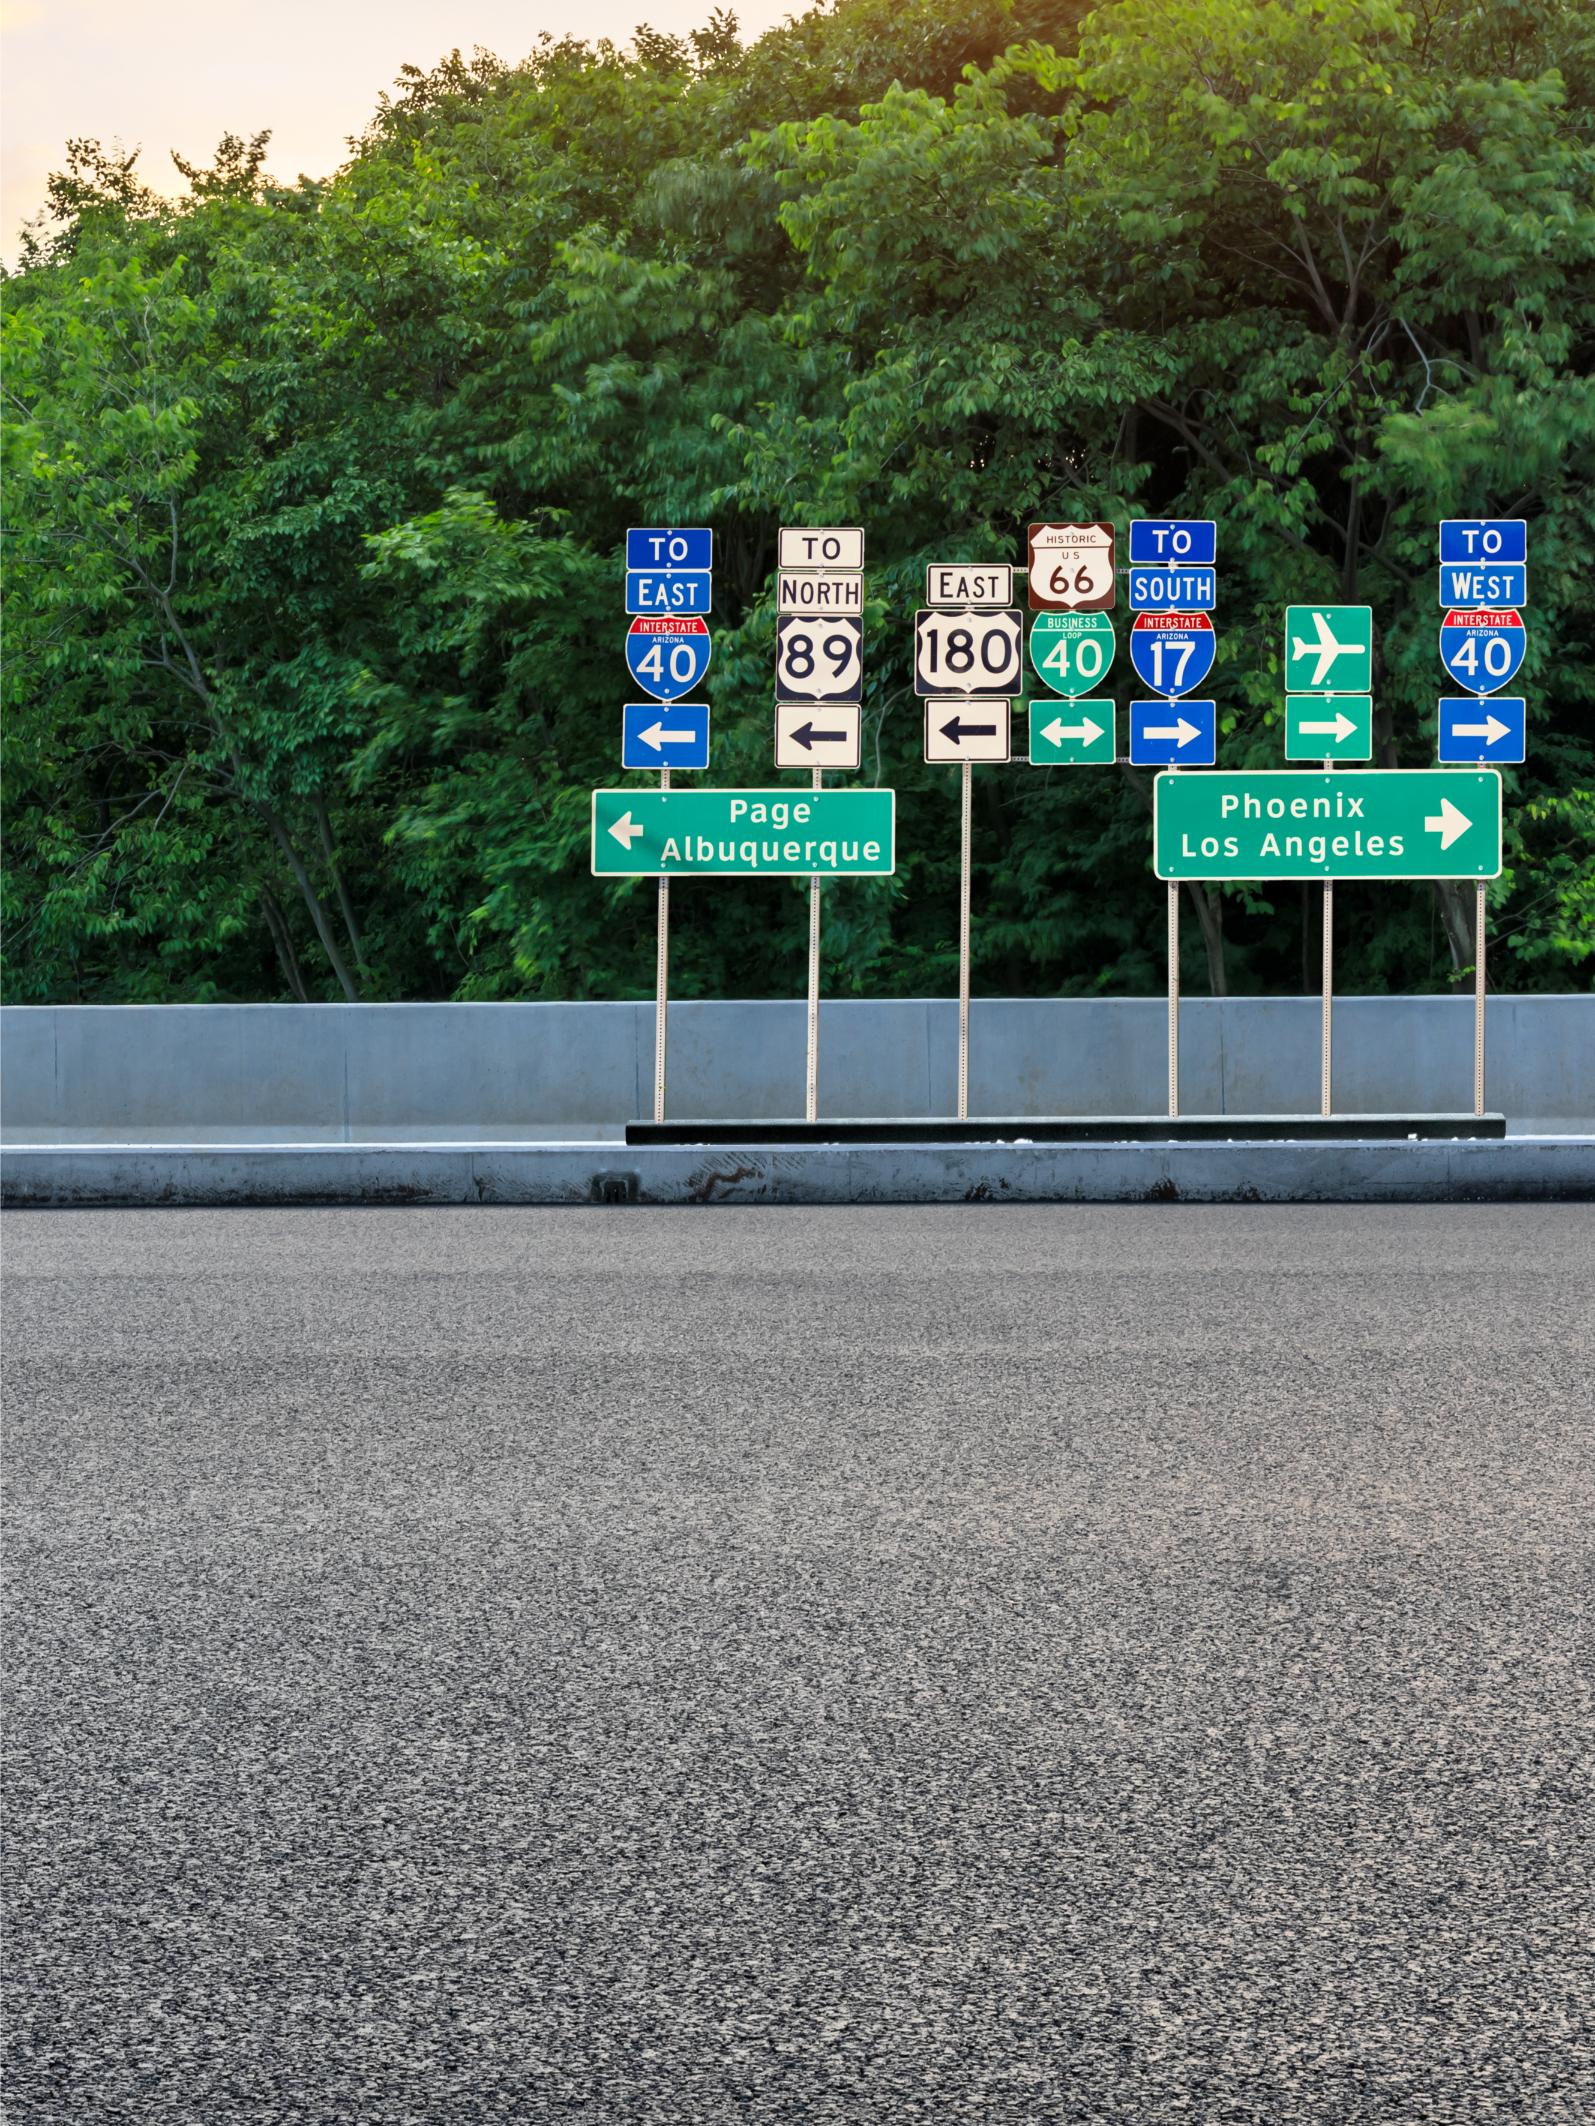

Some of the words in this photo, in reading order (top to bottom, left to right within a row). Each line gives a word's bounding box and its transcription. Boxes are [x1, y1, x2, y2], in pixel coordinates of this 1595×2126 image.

[648, 538, 688, 561] TO
[802, 537, 840, 560] TO
[1046, 535, 1097, 544] HISTORIC
[1152, 530, 1192, 553] TO
[1462, 530, 1502, 553] TO
[638, 578, 698, 606] EAST
[941, 572, 999, 598] EAST
[1049, 564, 1094, 594] 66
[1135, 577, 1210, 601] SOUTH
[1452, 572, 1514, 600] WEST
[782, 580, 859, 605] NORTH
[639, 622, 698, 632] INTERSTATE
[1048, 617, 1097, 628] BUSINESS
[1144, 617, 1202, 628] INTERSTATE
[1453, 614, 1512, 626] INTERSTATE
[1466, 629, 1498, 637] ARIZONA
[652, 636, 684, 644] ARIZONA
[926, 628, 1012, 673] 180
[637, 644, 696, 682] 40
[785, 634, 852, 678] 89
[1042, 639, 1103, 678] 40
[1151, 641, 1196, 687] 17
[1451, 637, 1511, 676] 40
[730, 799, 811, 830] Page
[1221, 792, 1365, 819] Phoenix
[661, 836, 881, 868] Albuquerque
[1182, 833, 1243, 857] Los
[1260, 831, 1404, 863] Angeles
